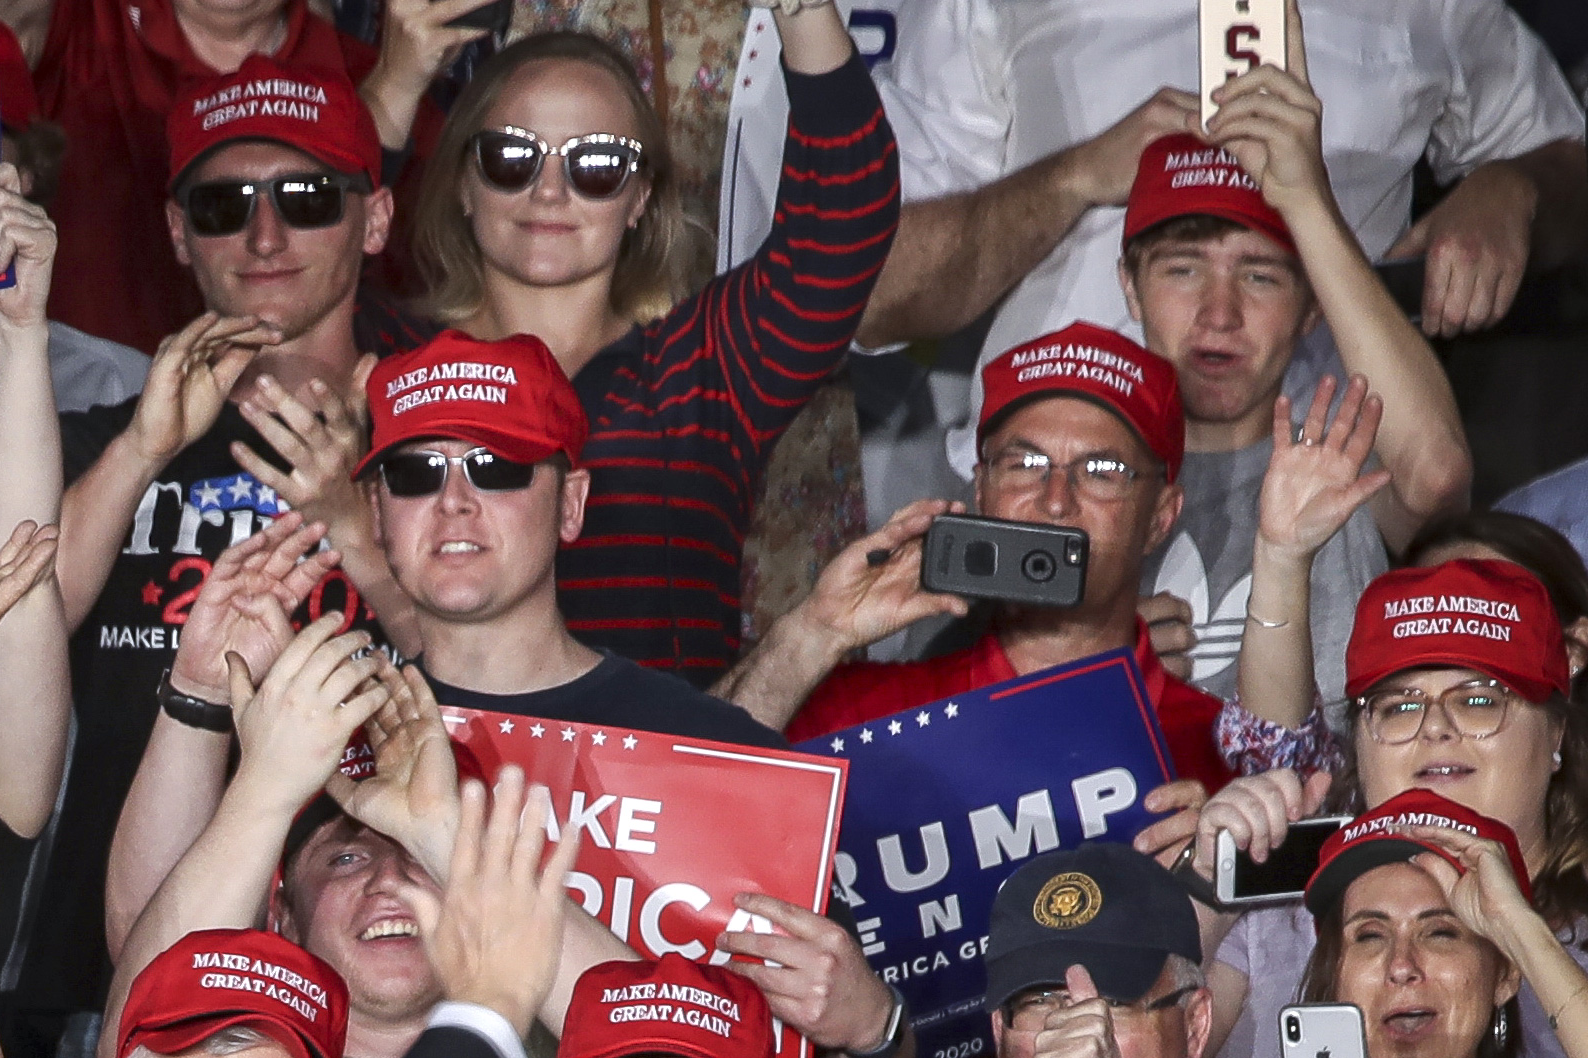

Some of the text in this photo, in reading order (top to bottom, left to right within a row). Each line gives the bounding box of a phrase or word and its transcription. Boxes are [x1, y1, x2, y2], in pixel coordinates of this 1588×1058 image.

[192, 79, 328, 116] MAKE AMERICA
[261, 99, 319, 123] AGAIN
[385, 362, 518, 398] MAKE AMERICA
[1010, 343, 1145, 385] MAKE AMERICA
[1017, 361, 1134, 397] GREAT AGAIN
[392, 384, 507, 416] GREAT AGAIN
[1384, 594, 1521, 622] MAKE AMERICA
[100, 626, 165, 649] MAKE
[1393, 618, 1511, 642] GREAT AGAIN
[834, 766, 1138, 908] RUMP
[192, 952, 328, 1010] MAKE AMERICA
[200, 973, 318, 1023] GREAT AGAIN
[600, 982, 741, 1022] MAKE AMERICA
[609, 1004, 732, 1037] GREAT AGAIN
